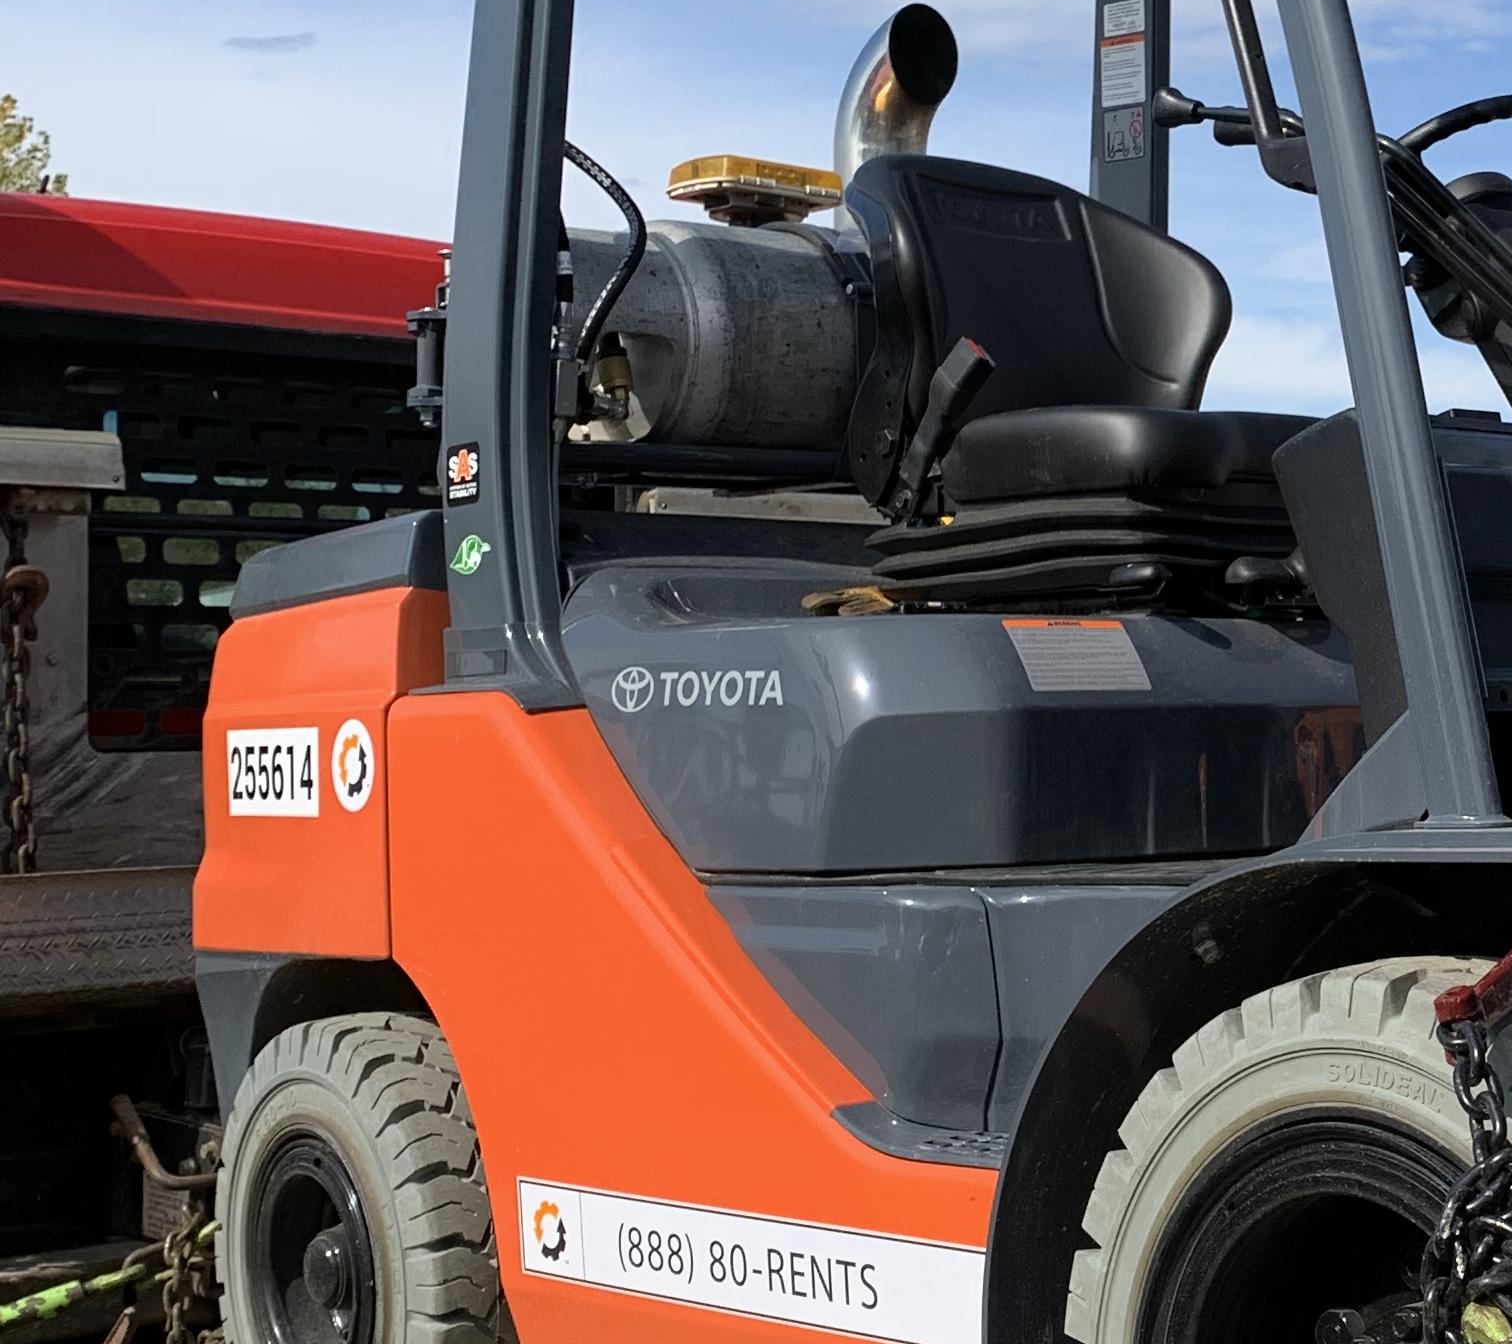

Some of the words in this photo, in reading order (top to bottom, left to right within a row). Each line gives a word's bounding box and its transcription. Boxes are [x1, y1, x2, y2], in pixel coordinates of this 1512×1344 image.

[448, 448, 478, 483] SAS
[659, 670, 784, 707] TOYOTA
[231, 744, 314, 800] 255614
[1327, 1062, 1442, 1114] SOLIDEAL
[618, 1222, 694, 1284] (888)
[709, 1240, 880, 1310] 80-RENTS
